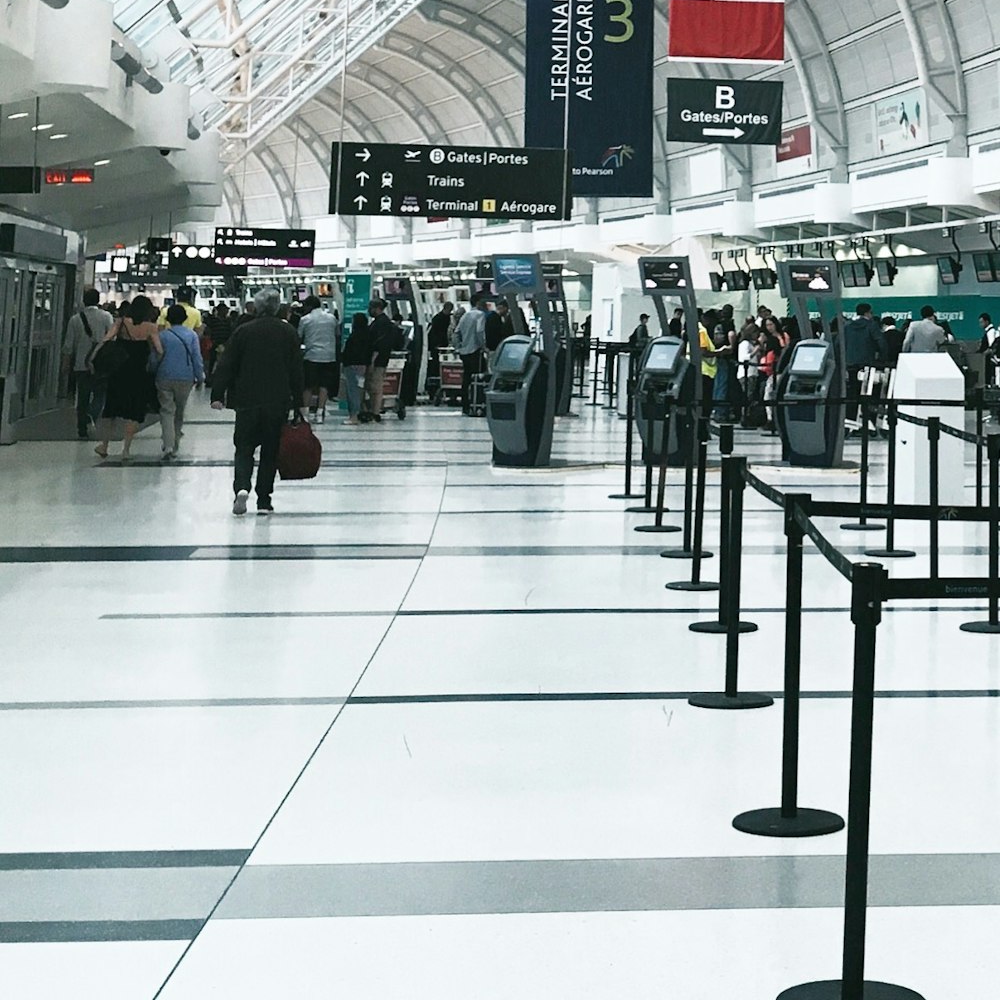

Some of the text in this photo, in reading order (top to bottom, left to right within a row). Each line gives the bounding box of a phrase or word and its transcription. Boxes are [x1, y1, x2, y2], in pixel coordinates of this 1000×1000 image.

[716, 86, 736, 109] B
[680, 110, 768, 124] Gates/Portes
[447, 152, 481, 164] Gates
[488, 153, 528, 165] Portes
[582, 167, 613, 176] Pearson
[427, 175, 464, 187] Trains
[426, 199, 478, 211] Terminal
[500, 200, 556, 214] Aérogare
